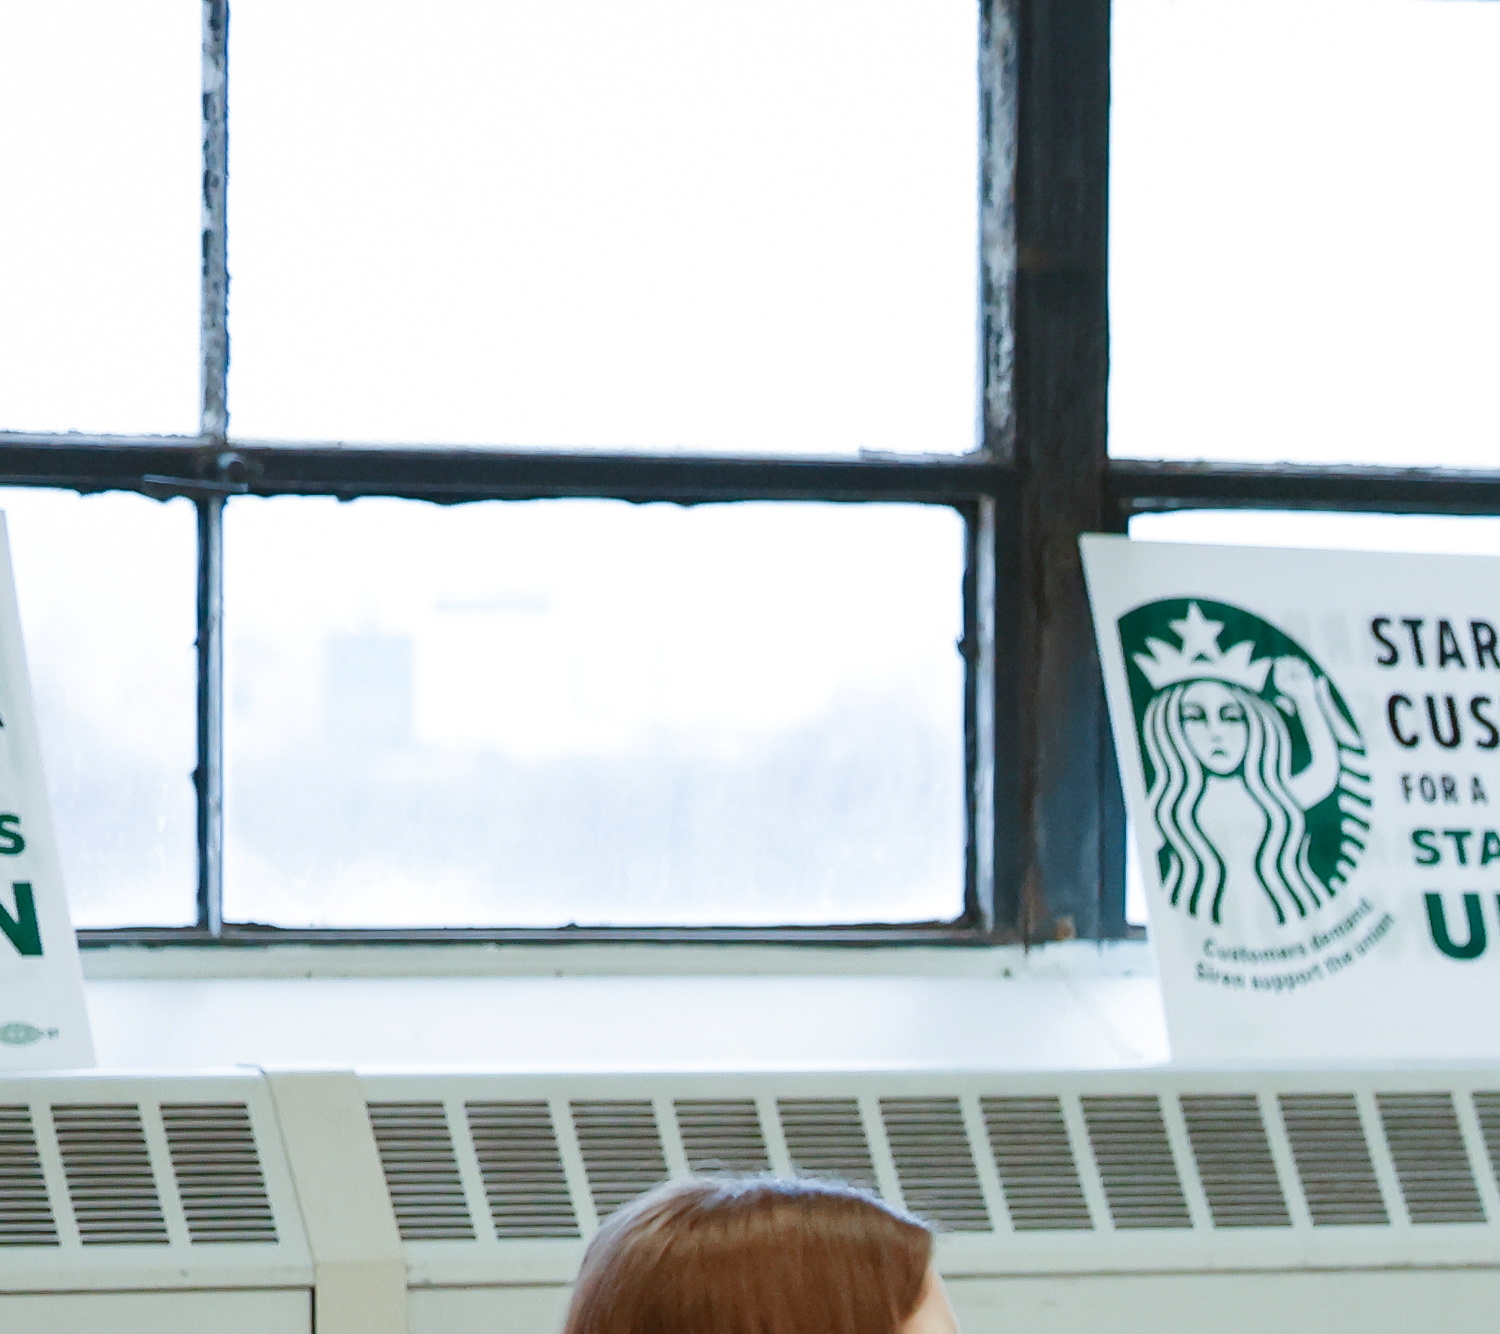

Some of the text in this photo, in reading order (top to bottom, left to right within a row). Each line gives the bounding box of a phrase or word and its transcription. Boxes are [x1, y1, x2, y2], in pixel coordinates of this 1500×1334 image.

[1401, 773, 1488, 804] FOR A
[1311, 898, 1375, 950] demand
